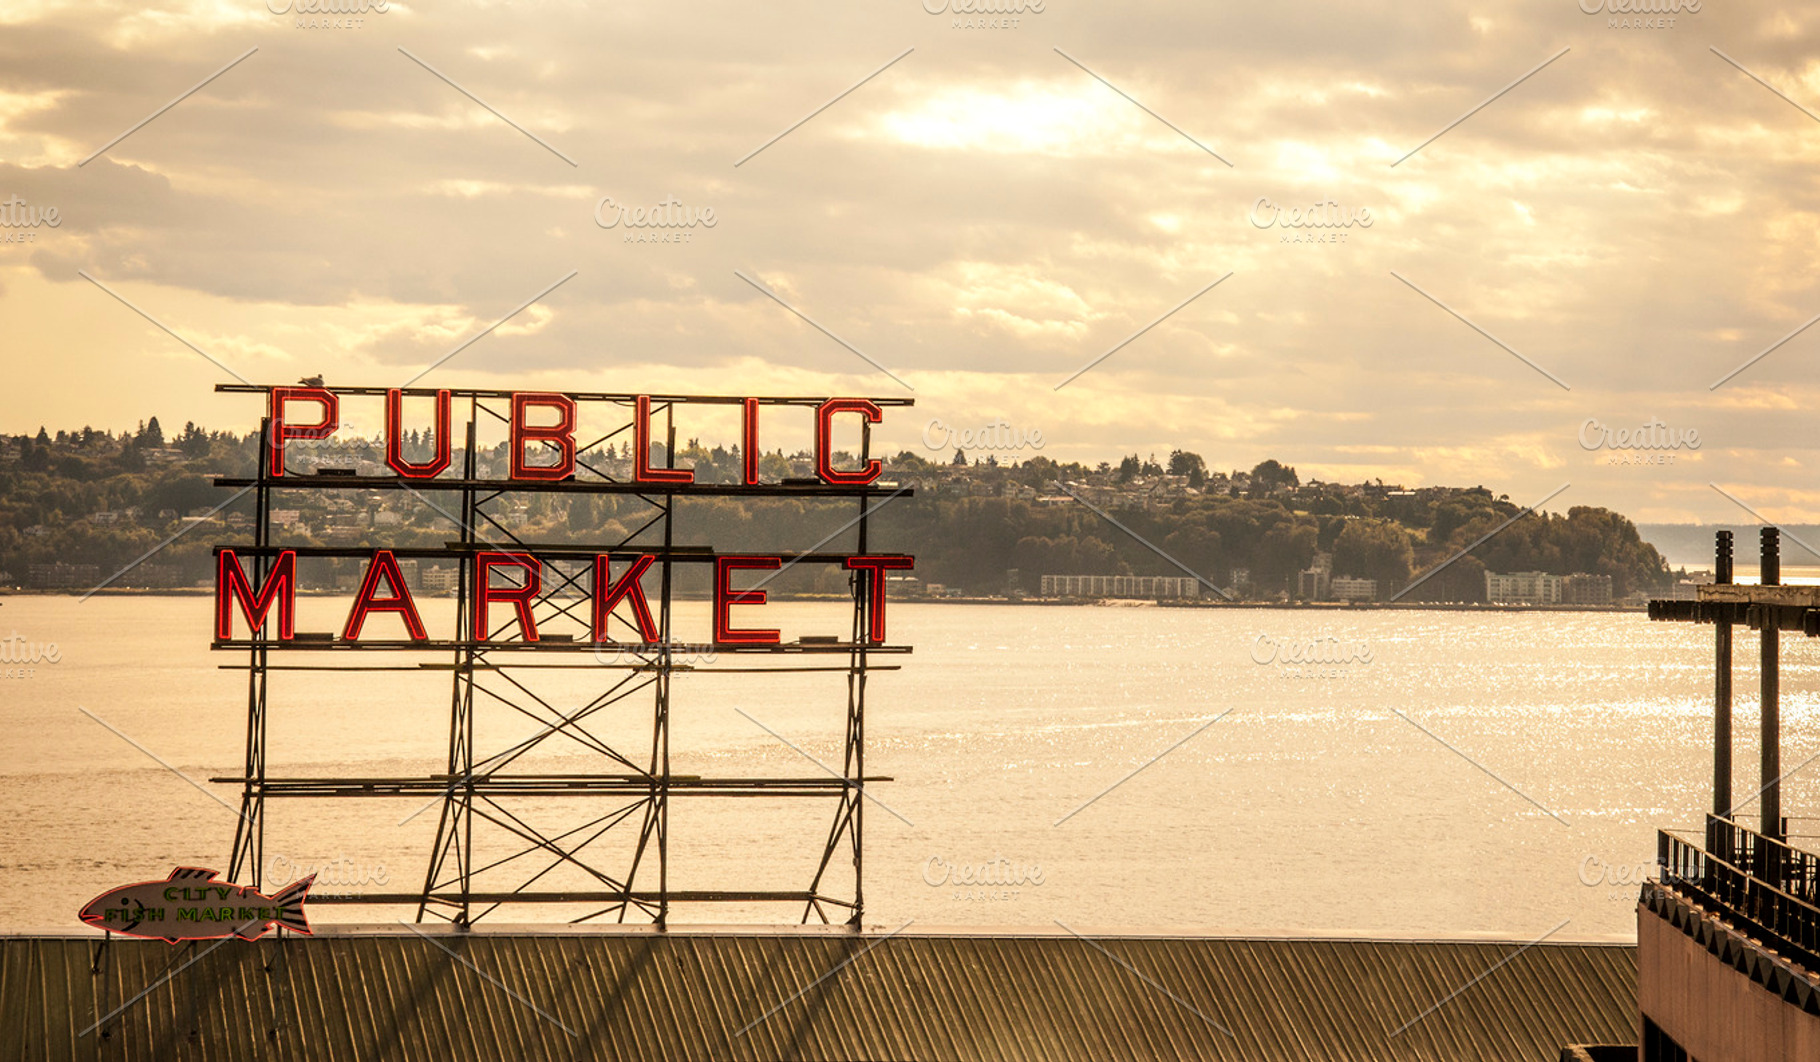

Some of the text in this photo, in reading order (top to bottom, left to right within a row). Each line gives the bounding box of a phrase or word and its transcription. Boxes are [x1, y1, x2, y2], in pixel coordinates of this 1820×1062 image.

[269, 387, 882, 485] PUBLIC
[215, 549, 915, 644] MARKET
[104, 906, 287, 923] FISH MARKET
[163, 886, 233, 901] CITY
